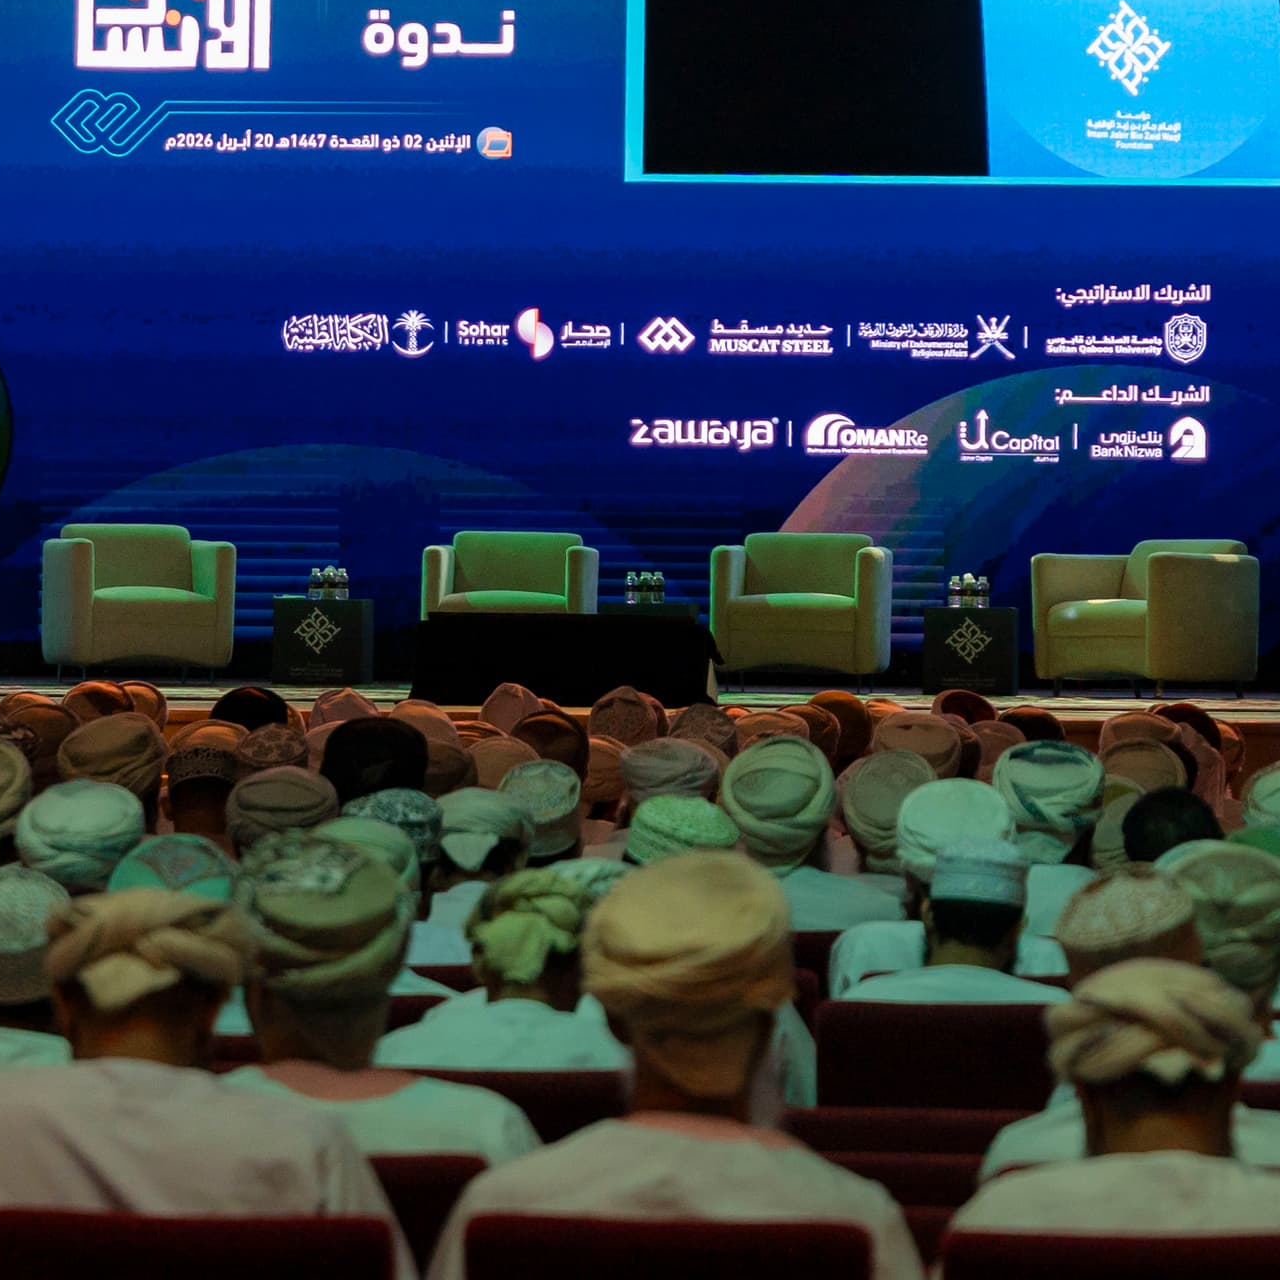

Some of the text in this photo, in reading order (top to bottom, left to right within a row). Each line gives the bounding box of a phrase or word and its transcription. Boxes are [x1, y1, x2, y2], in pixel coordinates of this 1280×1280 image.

[362, 9, 516, 67] ندوة
[216, 129, 252, 151] أبريل
[254, 134, 273, 148] 20
[329, 134, 379, 150] القعدة
[382, 134, 401, 152] ذو
[404, 134, 422, 148] 02
[426, 133, 471, 153] الإثنين
[1154, 284, 1211, 305] الشريك
[457, 320, 510, 336] Sohar
[560, 321, 611, 340] صحار
[711, 319, 833, 338] حديد مسقط
[458, 336, 509, 346] Islamic
[710, 338, 834, 354] MUSCAT STEEL
[1046, 345, 1163, 356] Sultan Qaboos University
[1141, 385, 1211, 406] الشريك
[631, 419, 774, 450] zawaya
[991, 430, 1060, 453] Capital
[1100, 431, 1163, 446] بنك نزوى
[1091, 445, 1163, 458] Bank Nizwa
